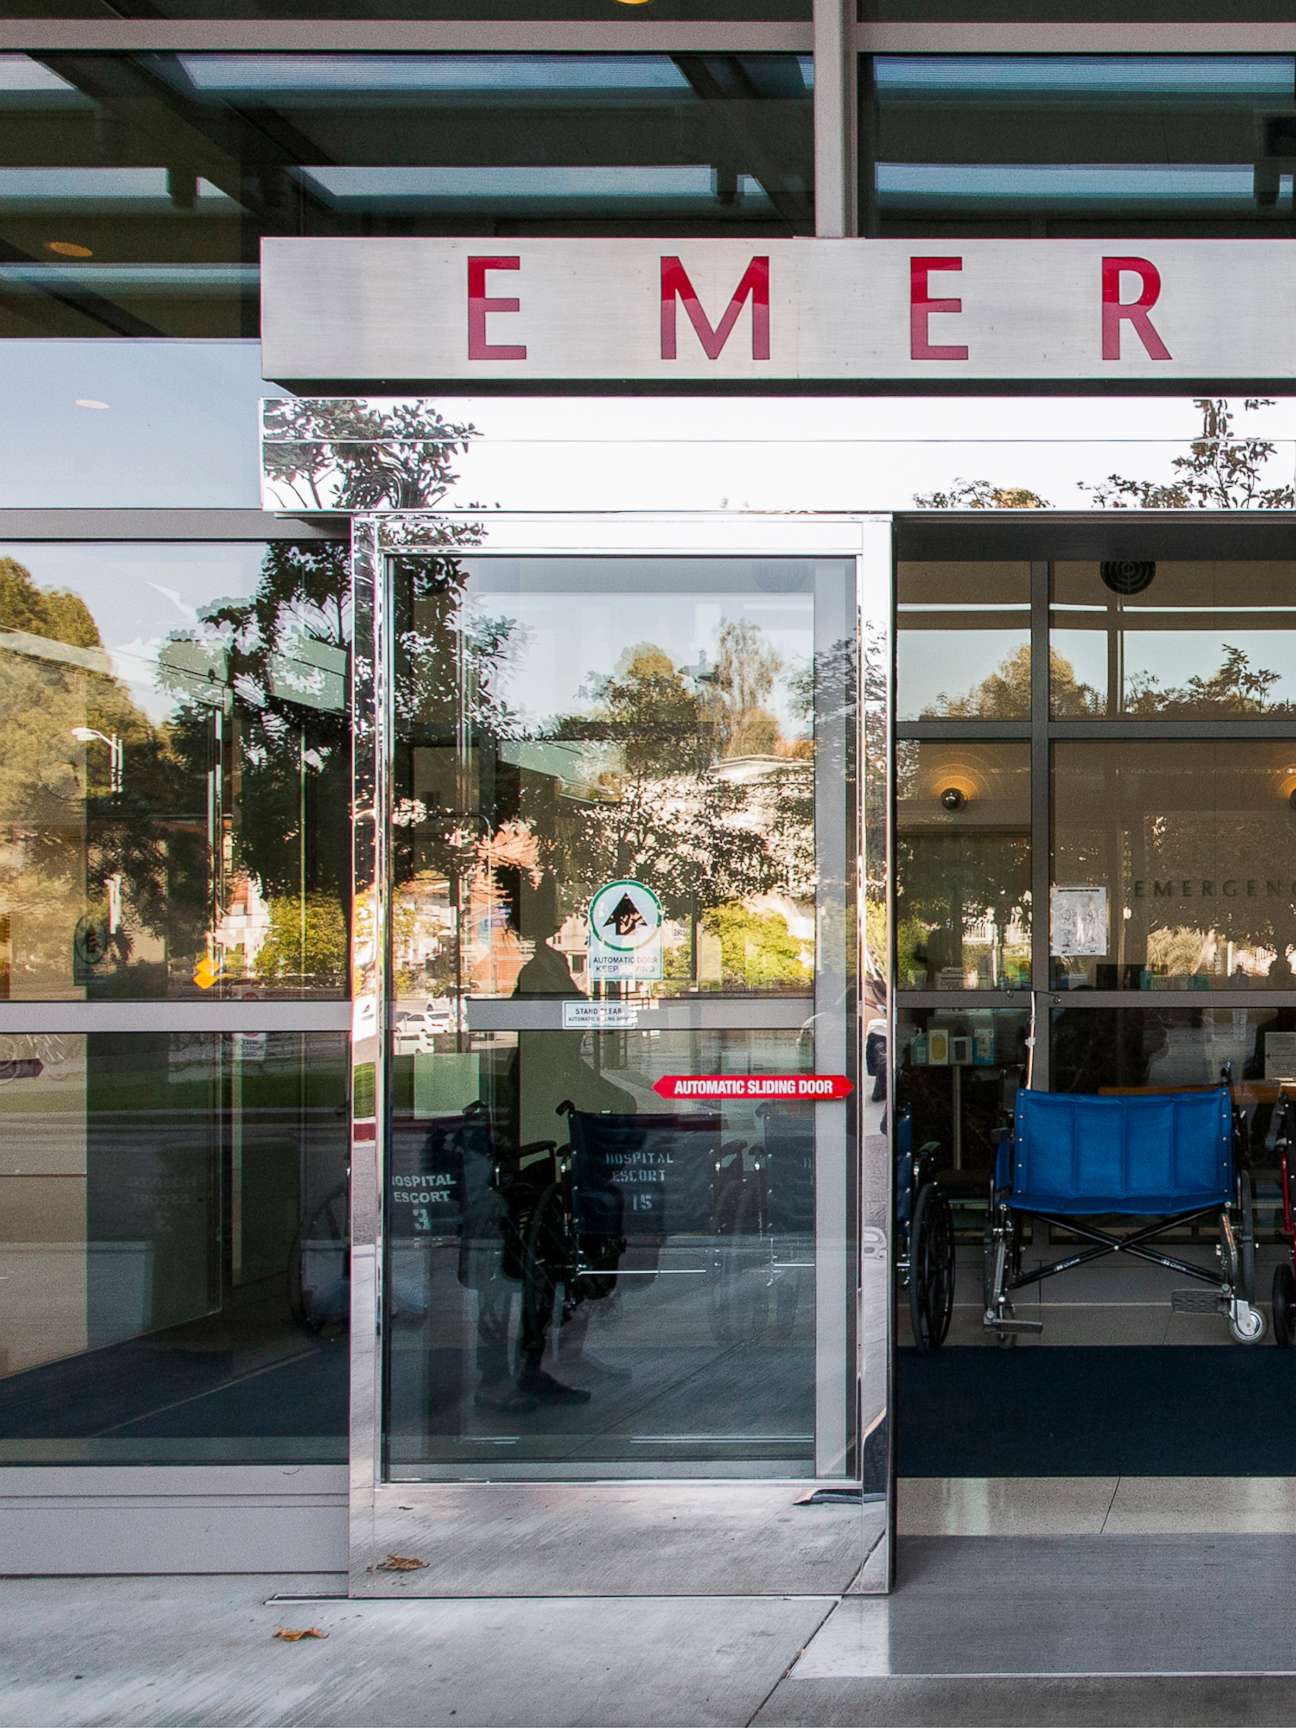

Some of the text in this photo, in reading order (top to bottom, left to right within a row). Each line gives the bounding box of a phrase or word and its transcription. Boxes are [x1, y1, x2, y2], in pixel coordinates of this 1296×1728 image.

[593, 956, 635, 964] AUTOMATIC
[575, 1007, 598, 1015] STAND
[674, 1080, 833, 1095] AUTOMATIC SLIDING DOOR
[605, 1151, 675, 1165] HOSPITAL
[611, 1169, 666, 1182] ESCORT
[393, 1190, 451, 1203] ESCORT
